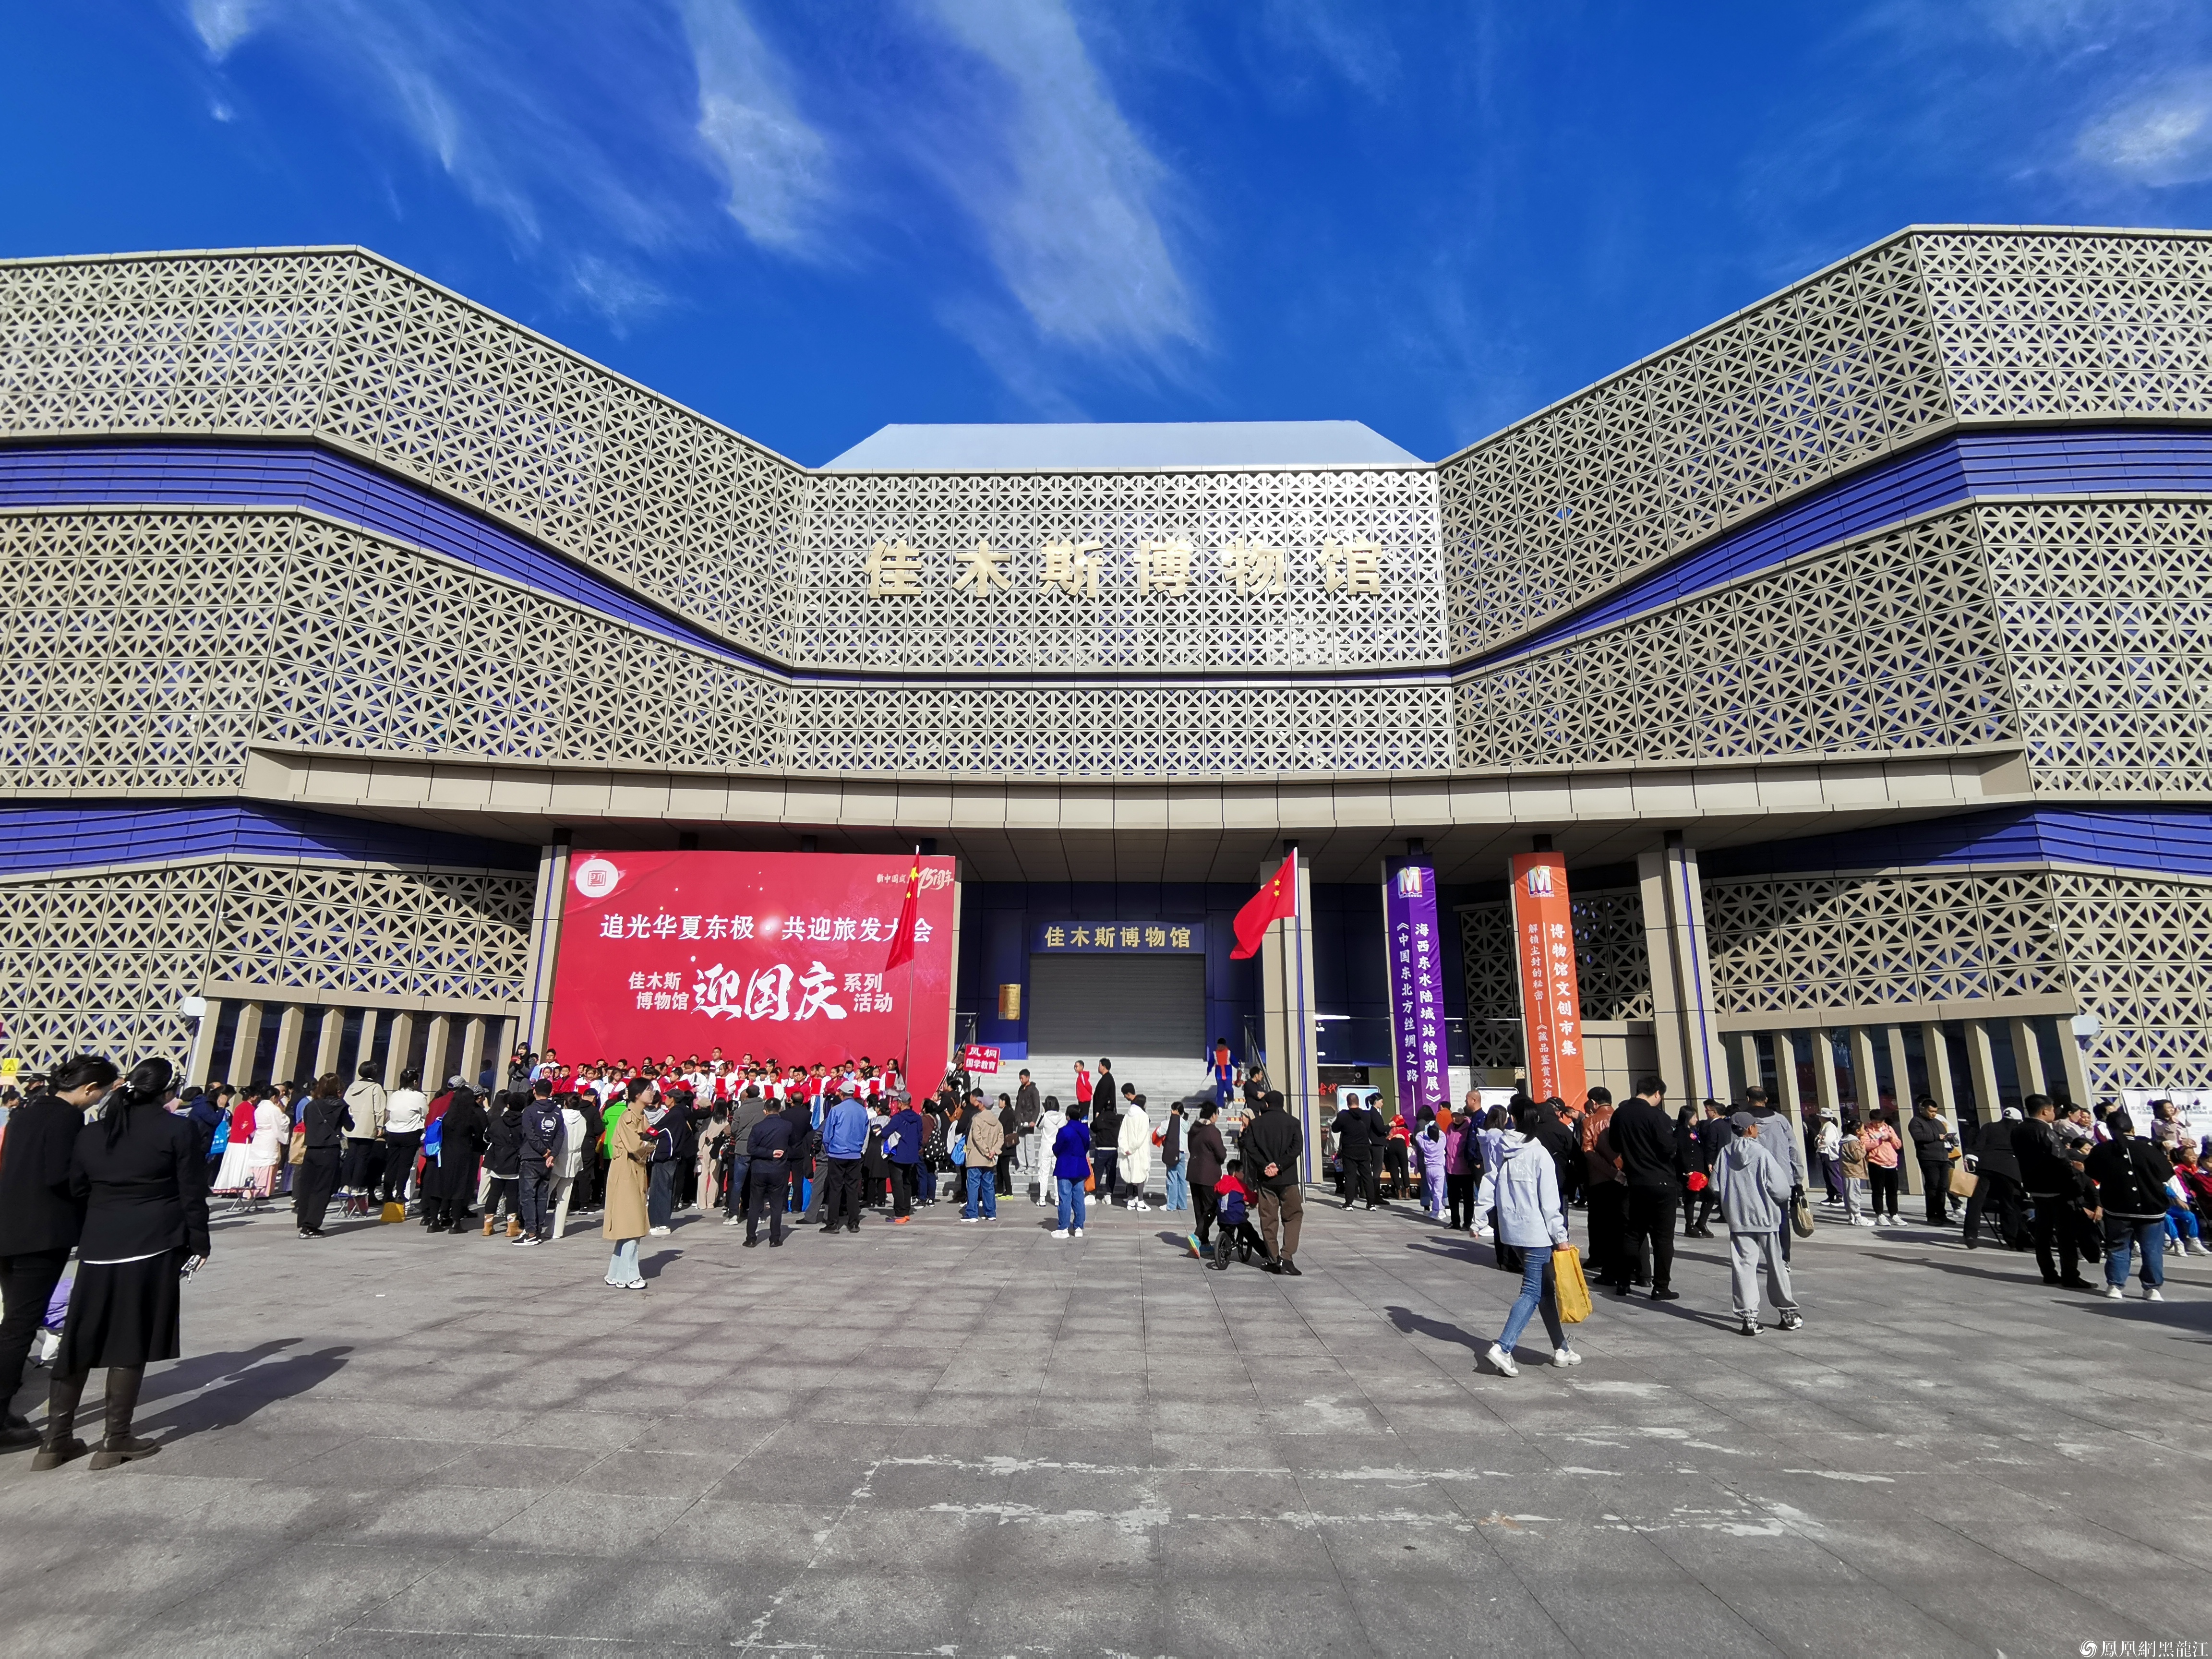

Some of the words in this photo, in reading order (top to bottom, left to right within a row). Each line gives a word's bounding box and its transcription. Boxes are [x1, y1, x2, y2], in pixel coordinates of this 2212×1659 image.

[863, 537, 1382, 599] 佳木斯博物馆
[600, 913, 754, 939] 追光华夏东极
[1045, 926, 1191, 948] 佳木斯博物馆
[628, 971, 682, 990] 佳木斯
[690, 961, 847, 1021] 迎国庆
[843, 973, 883, 993] 系列
[1550, 924, 1577, 1056] 博物馆文创市集
[636, 992, 689, 1010] 博物馆
[854, 992, 893, 1012] 活动
[966, 1058, 996, 1071] 国学教育
